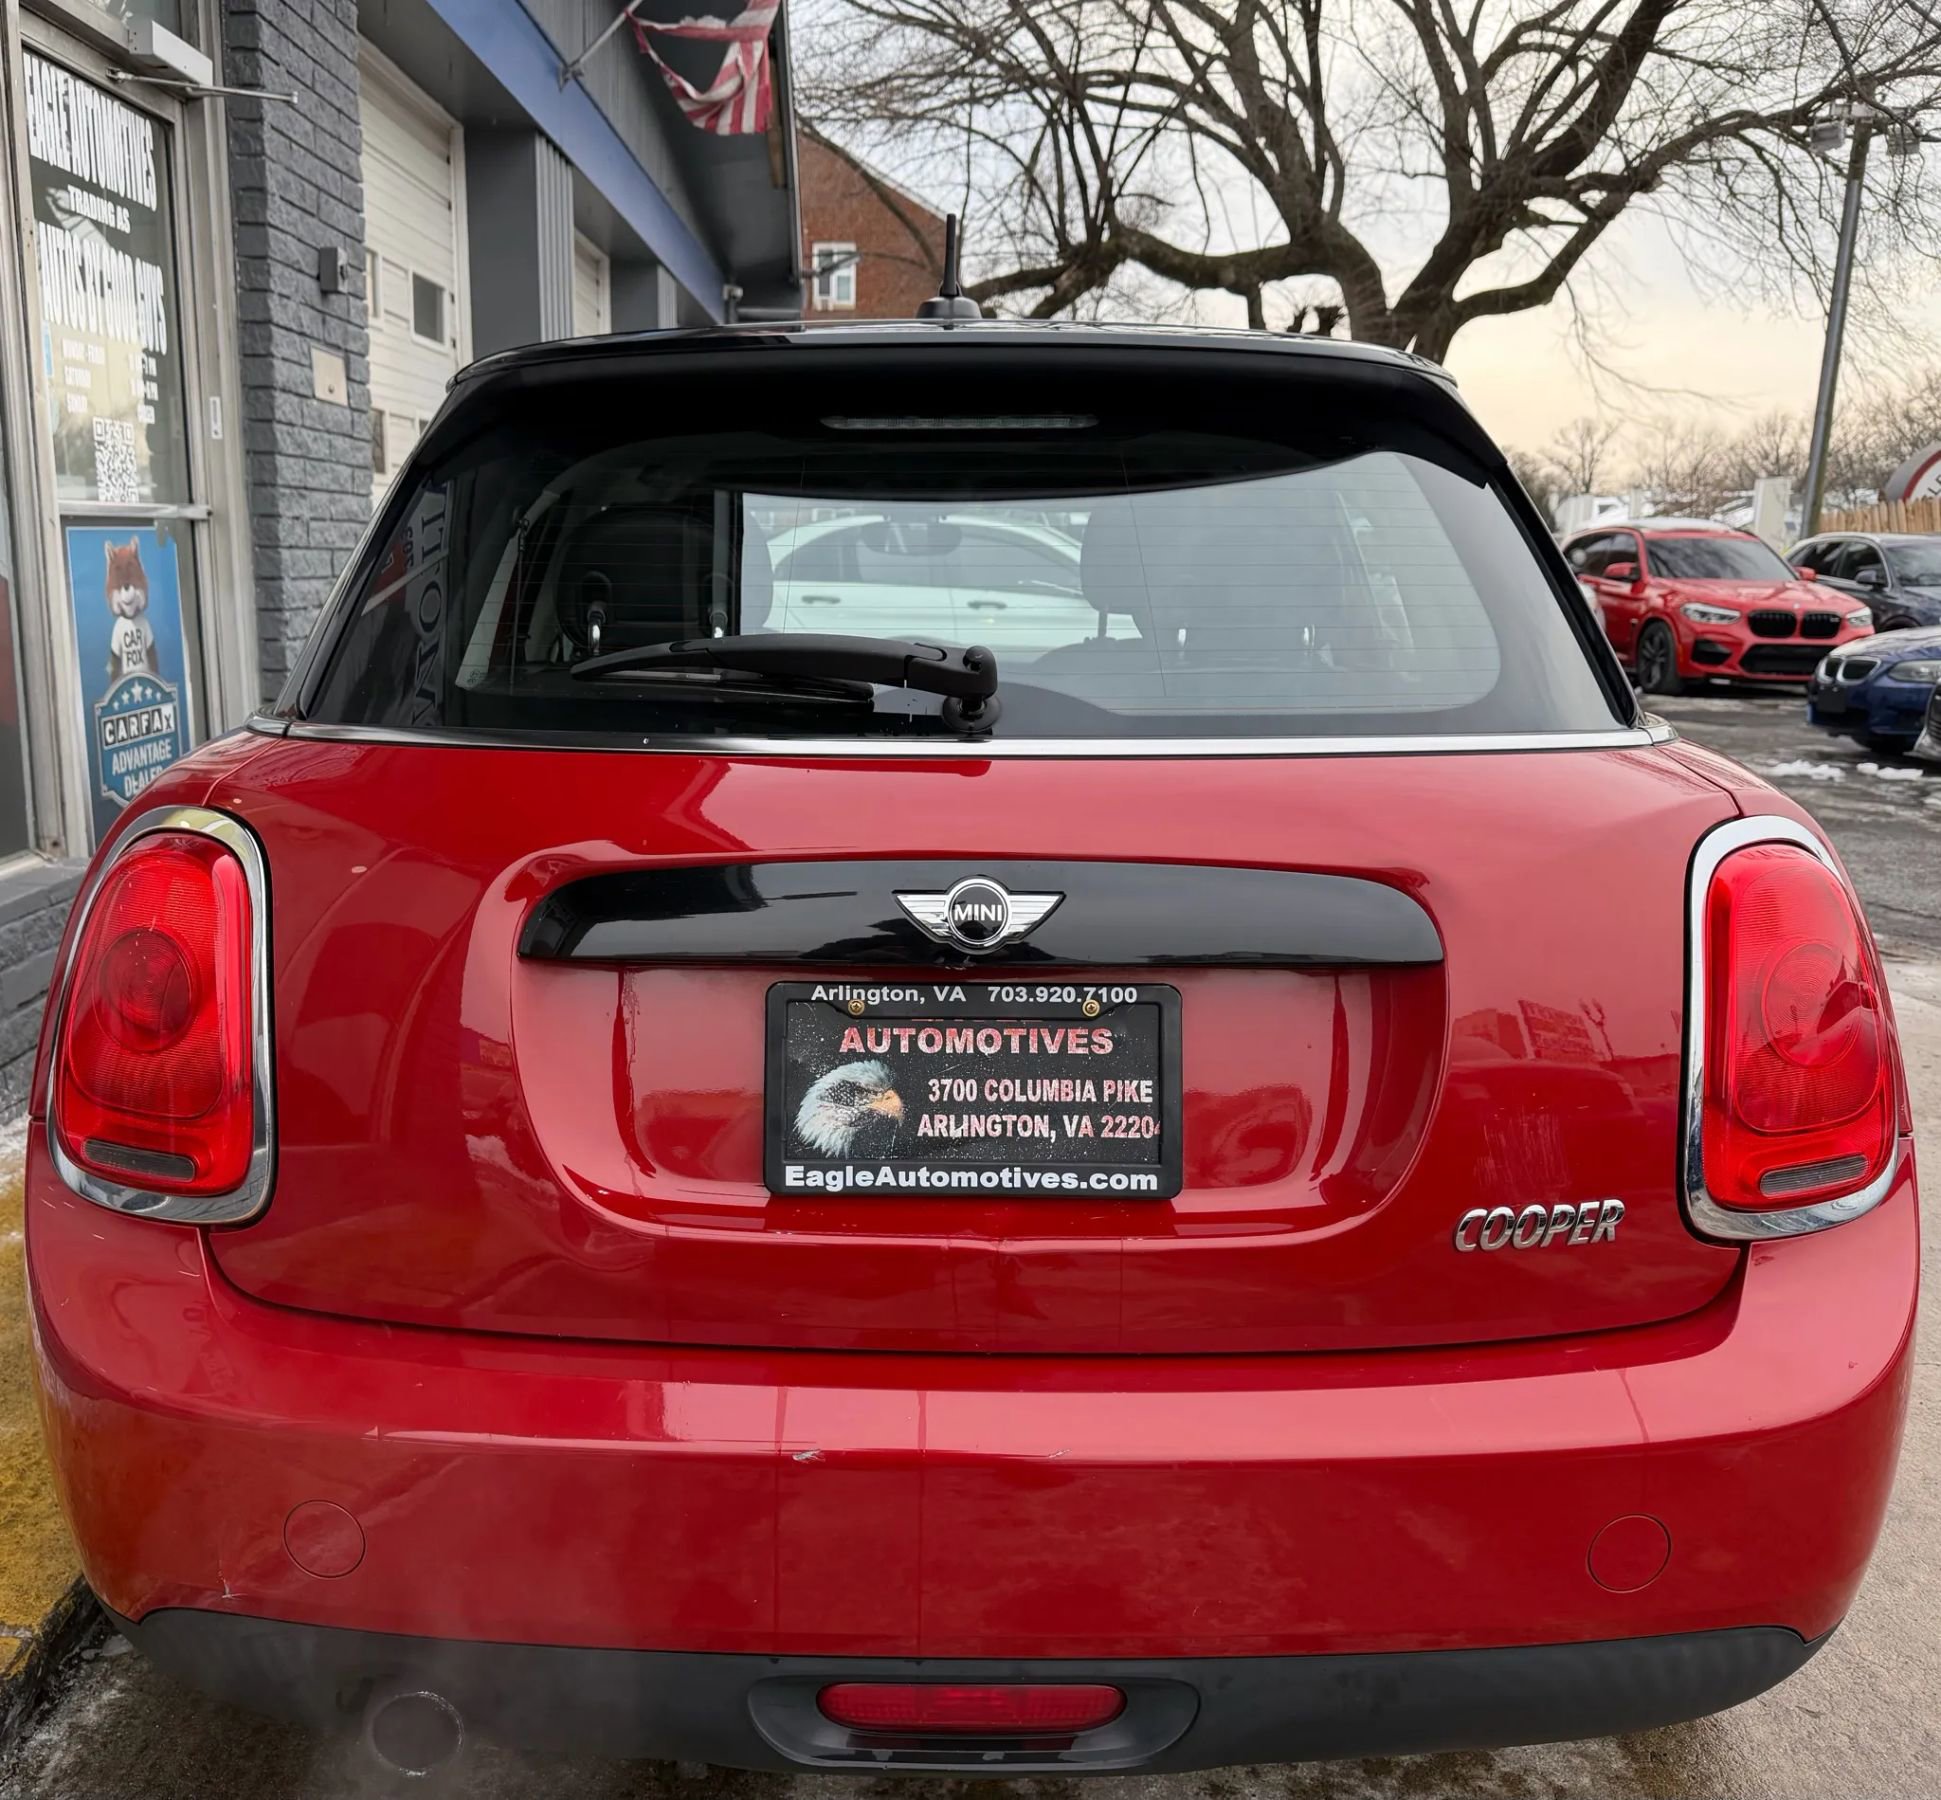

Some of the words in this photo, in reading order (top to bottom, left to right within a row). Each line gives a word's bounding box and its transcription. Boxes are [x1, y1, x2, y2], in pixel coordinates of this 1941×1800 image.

[23, 52, 72, 172] EAGLE
[67, 77, 158, 212] AUTOMOTIVES
[67, 184, 116, 228] TRADING
[116, 206, 131, 234] AS
[39, 221, 86, 333] AUTOS
[123, 629, 143, 648] CAR
[126, 649, 145, 666] FOX
[105, 711, 172, 743] CARFAX
[112, 738, 172, 776] ADVANTAGE
[954, 904, 1002, 921] MINI
[811, 985, 926, 1004] Arlington,
[933, 986, 966, 1001] VA
[987, 986, 1137, 1003] 703.920.7100
[839, 1027, 1114, 1055] AUTOMOTIVES
[928, 1079, 977, 1102] 3700
[984, 1079, 1097, 1102] COLUMBIA
[1103, 1079, 1153, 1103] PIKE
[917, 1115, 1057, 1143] ARLINGTON,
[1064, 1115, 1095, 1138] VA
[785, 1166, 1158, 1193] EagleAutomotives.com
[1455, 1199, 1625, 1252] COOPER
